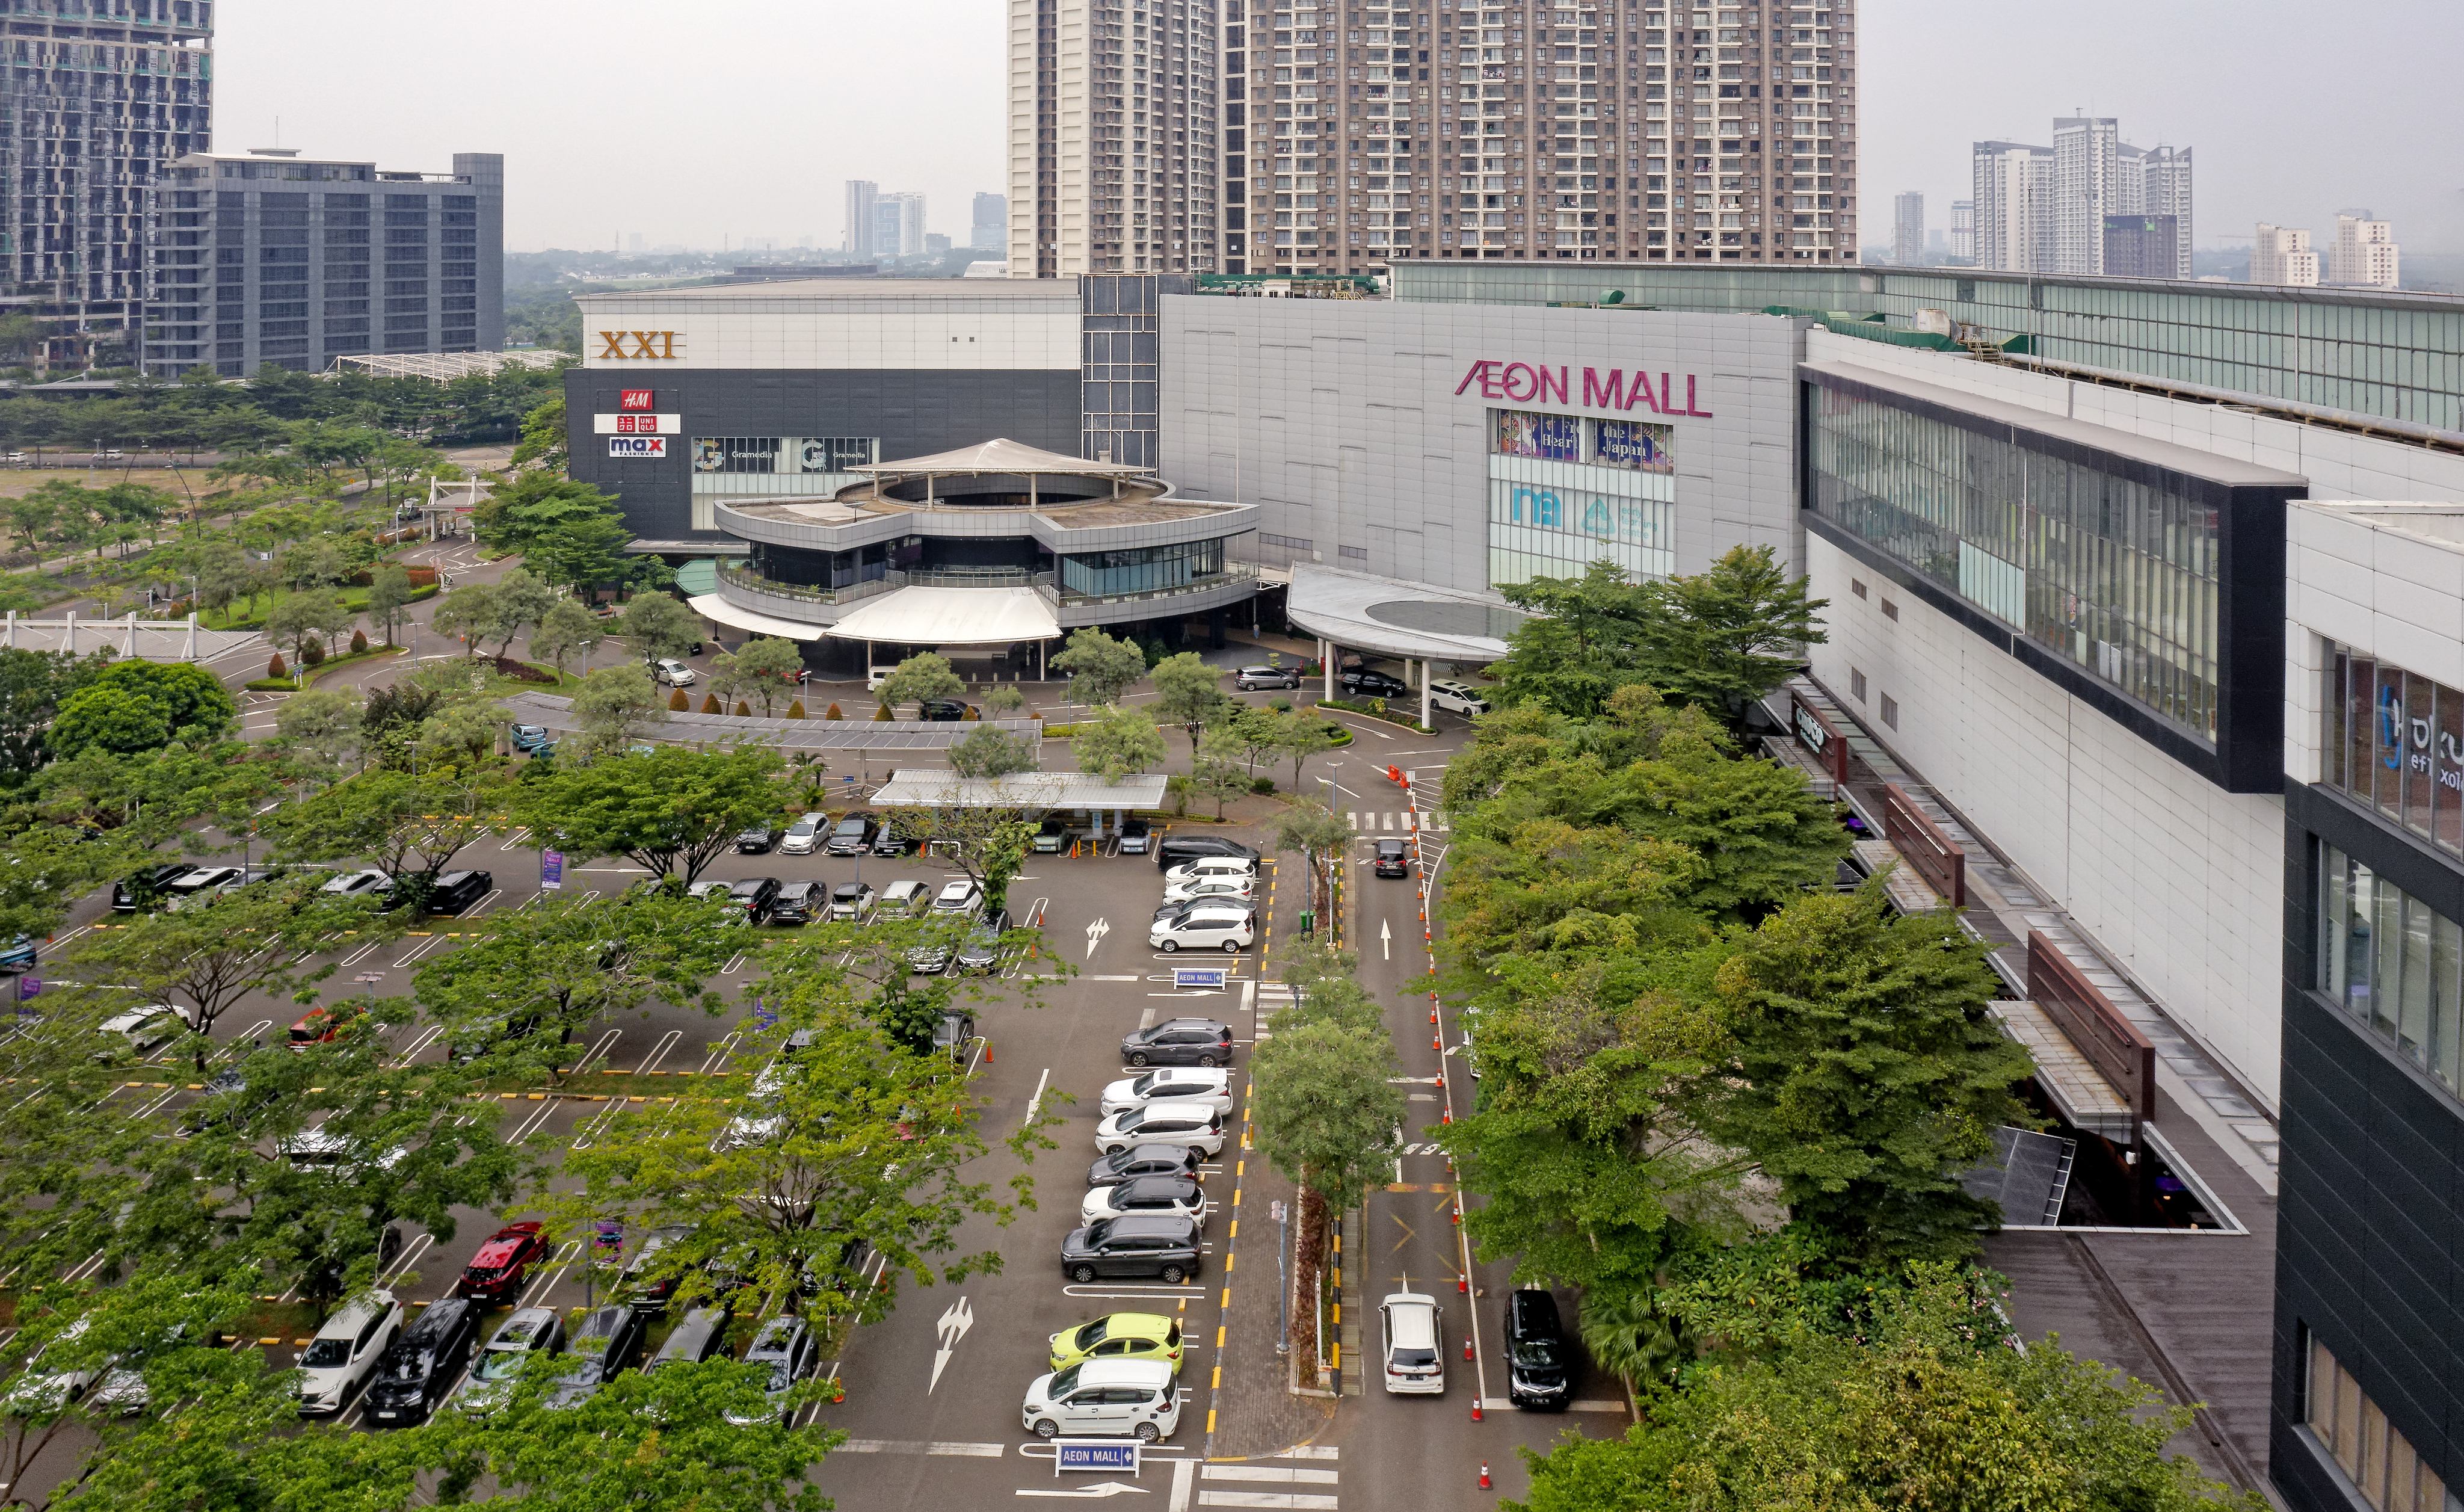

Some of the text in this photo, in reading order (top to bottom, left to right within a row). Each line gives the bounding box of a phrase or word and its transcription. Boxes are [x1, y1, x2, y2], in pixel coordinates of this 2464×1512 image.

[599, 331, 675, 359] XXI
[1583, 366, 1713, 418] MALL
[624, 392, 648, 407] H&M
[1603, 425, 1625, 438] the
[611, 439, 664, 451] max
[1603, 441, 1646, 457] Japan
[1621, 528, 1649, 539] cente
[1063, 1451, 1120, 1462] AEON MALL
